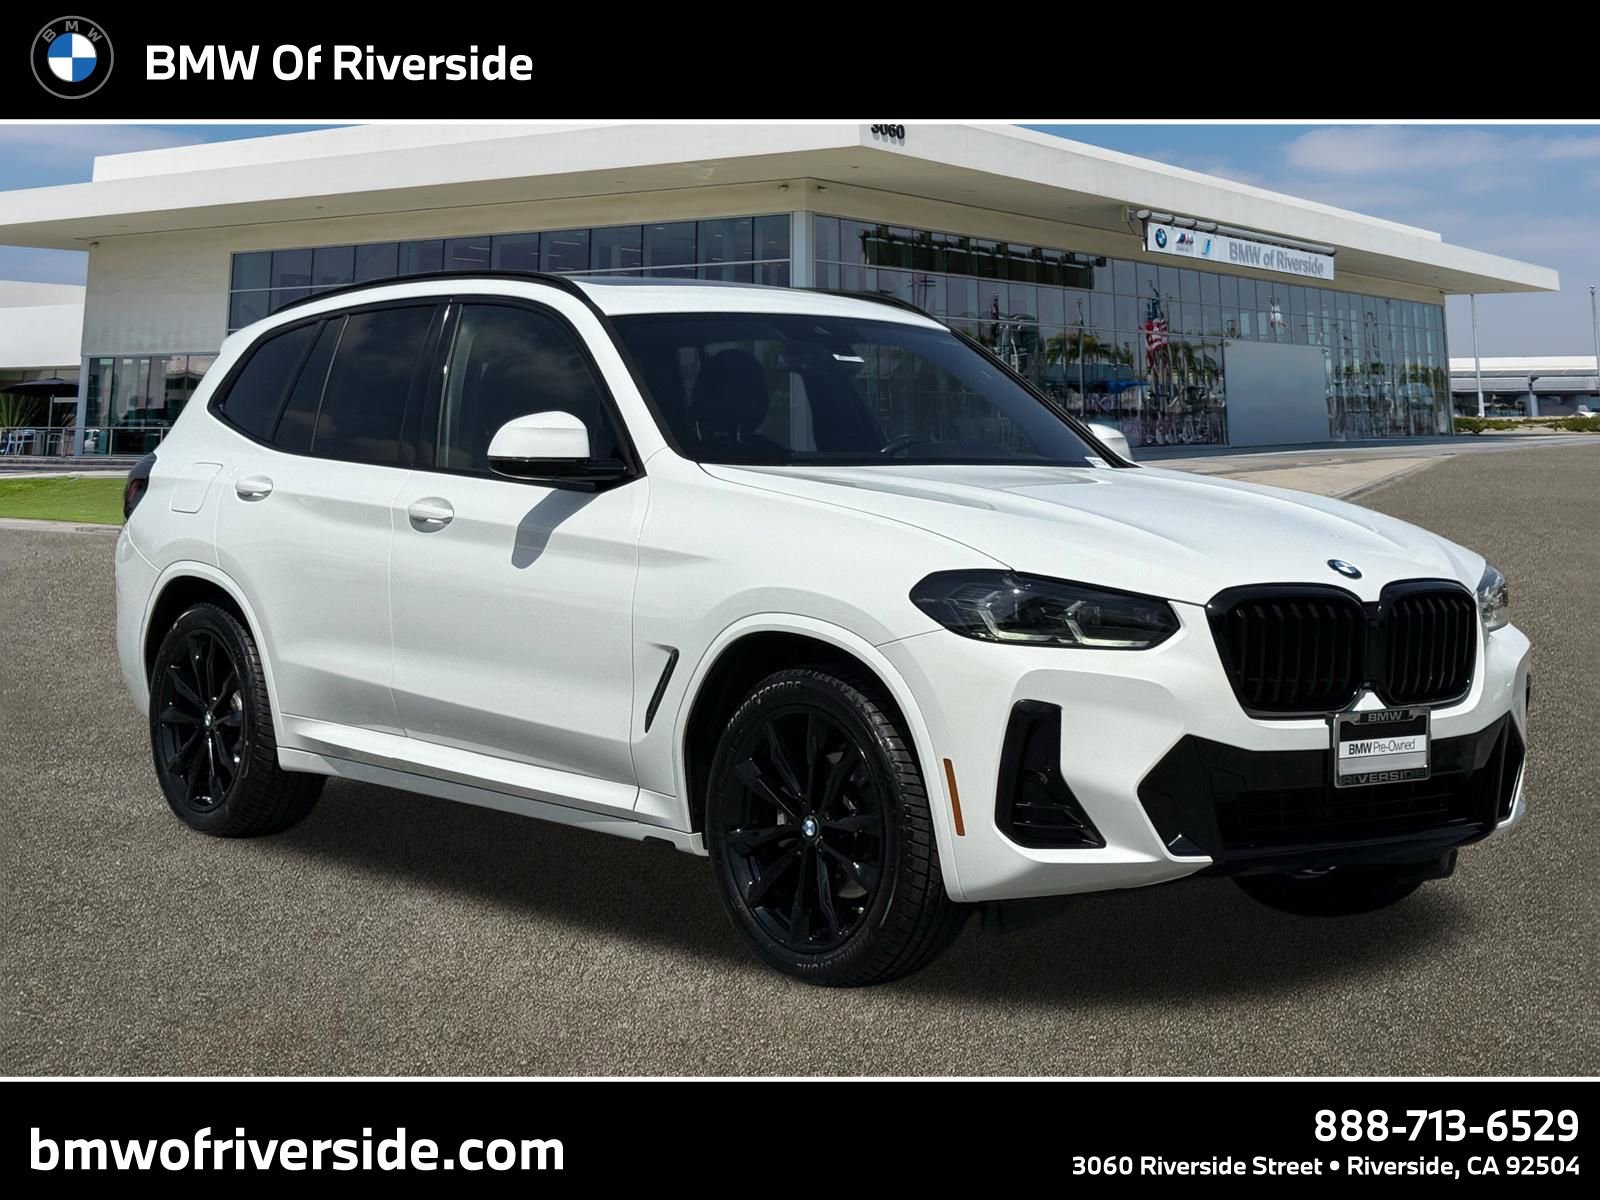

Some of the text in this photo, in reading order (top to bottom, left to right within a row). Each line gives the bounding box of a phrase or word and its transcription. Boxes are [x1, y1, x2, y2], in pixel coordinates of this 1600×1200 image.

[1229, 242, 1261, 265] BMW
[1263, 251, 1276, 267] of
[1276, 252, 1324, 276] Riverside
[1368, 711, 1402, 722] BMW
[1349, 738, 1416, 755] BMW Pre-Owned
